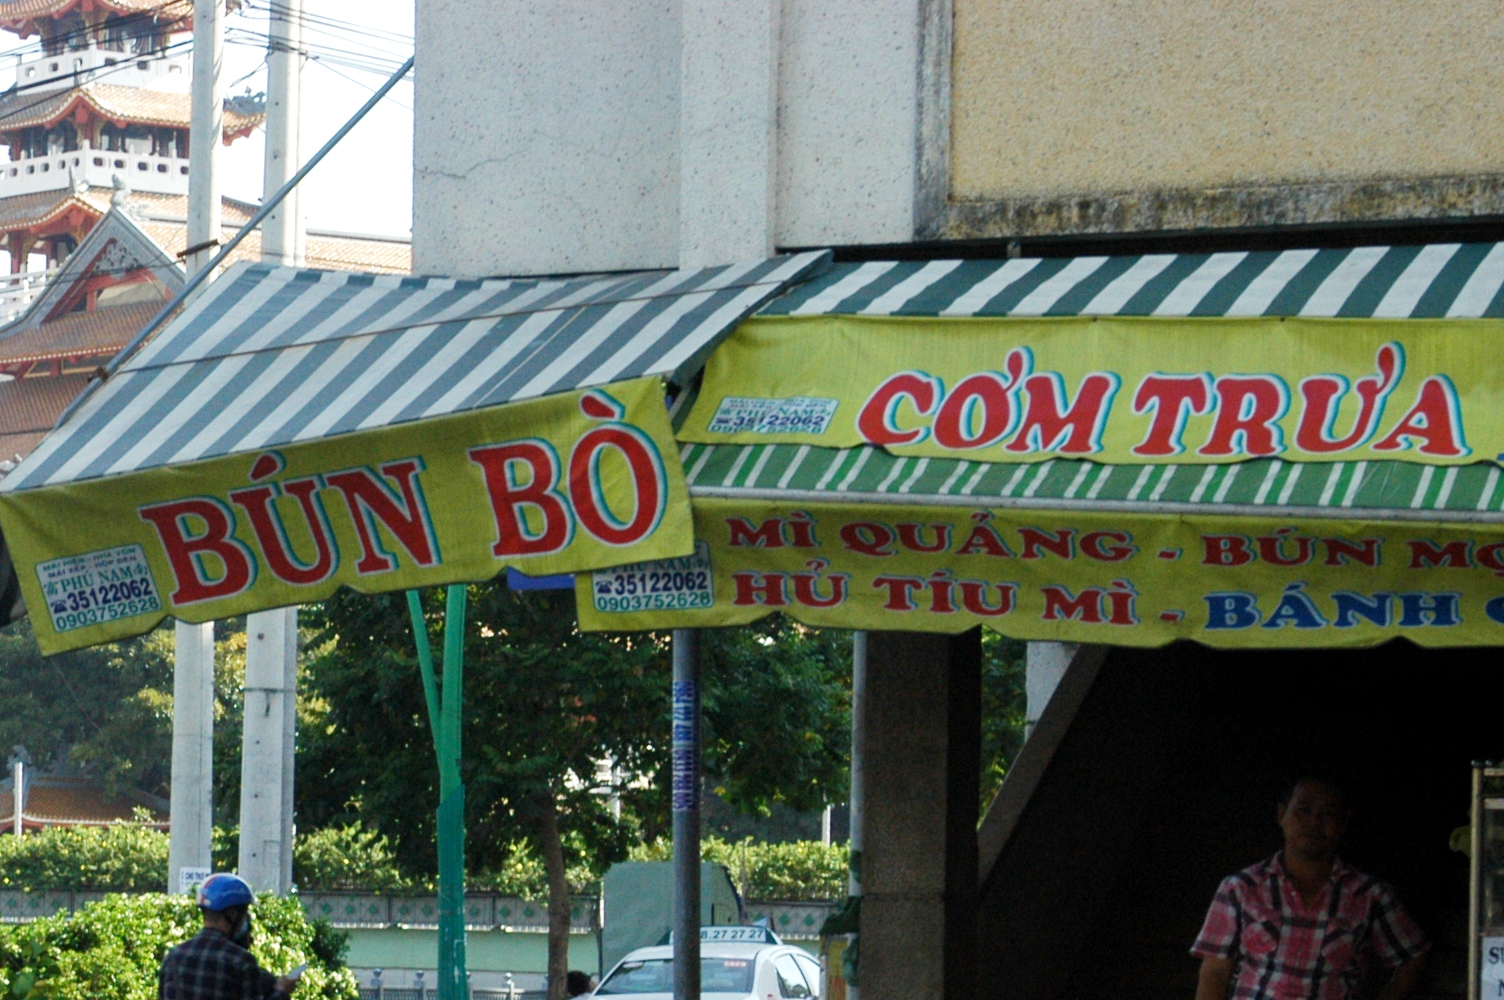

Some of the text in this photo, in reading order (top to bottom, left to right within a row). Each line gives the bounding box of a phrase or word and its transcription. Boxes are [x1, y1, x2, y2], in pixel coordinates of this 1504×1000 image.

[856, 339, 1471, 459] CƠM TRƯA
[138, 387, 668, 607] BÚN BÒ
[726, 509, 823, 549] MÌ
[840, 509, 1139, 562] QUẢNG
[1200, 526, 1384, 568] BÚN
[98, 566, 134, 584] NAM
[614, 571, 708, 596] 35122062
[67, 577, 153, 612] 35122062
[597, 591, 711, 611] 0903752628
[732, 556, 852, 608] HỦ
[872, 569, 1019, 617] TÍU
[1041, 578, 1140, 626] MÌ
[1203, 581, 1463, 629] BÁNH
[56, 596, 159, 630] 0903752628
[731, 929, 746, 939] 27
[749, 928, 764, 939] 27
[1488, 943, 1504, 965] S
